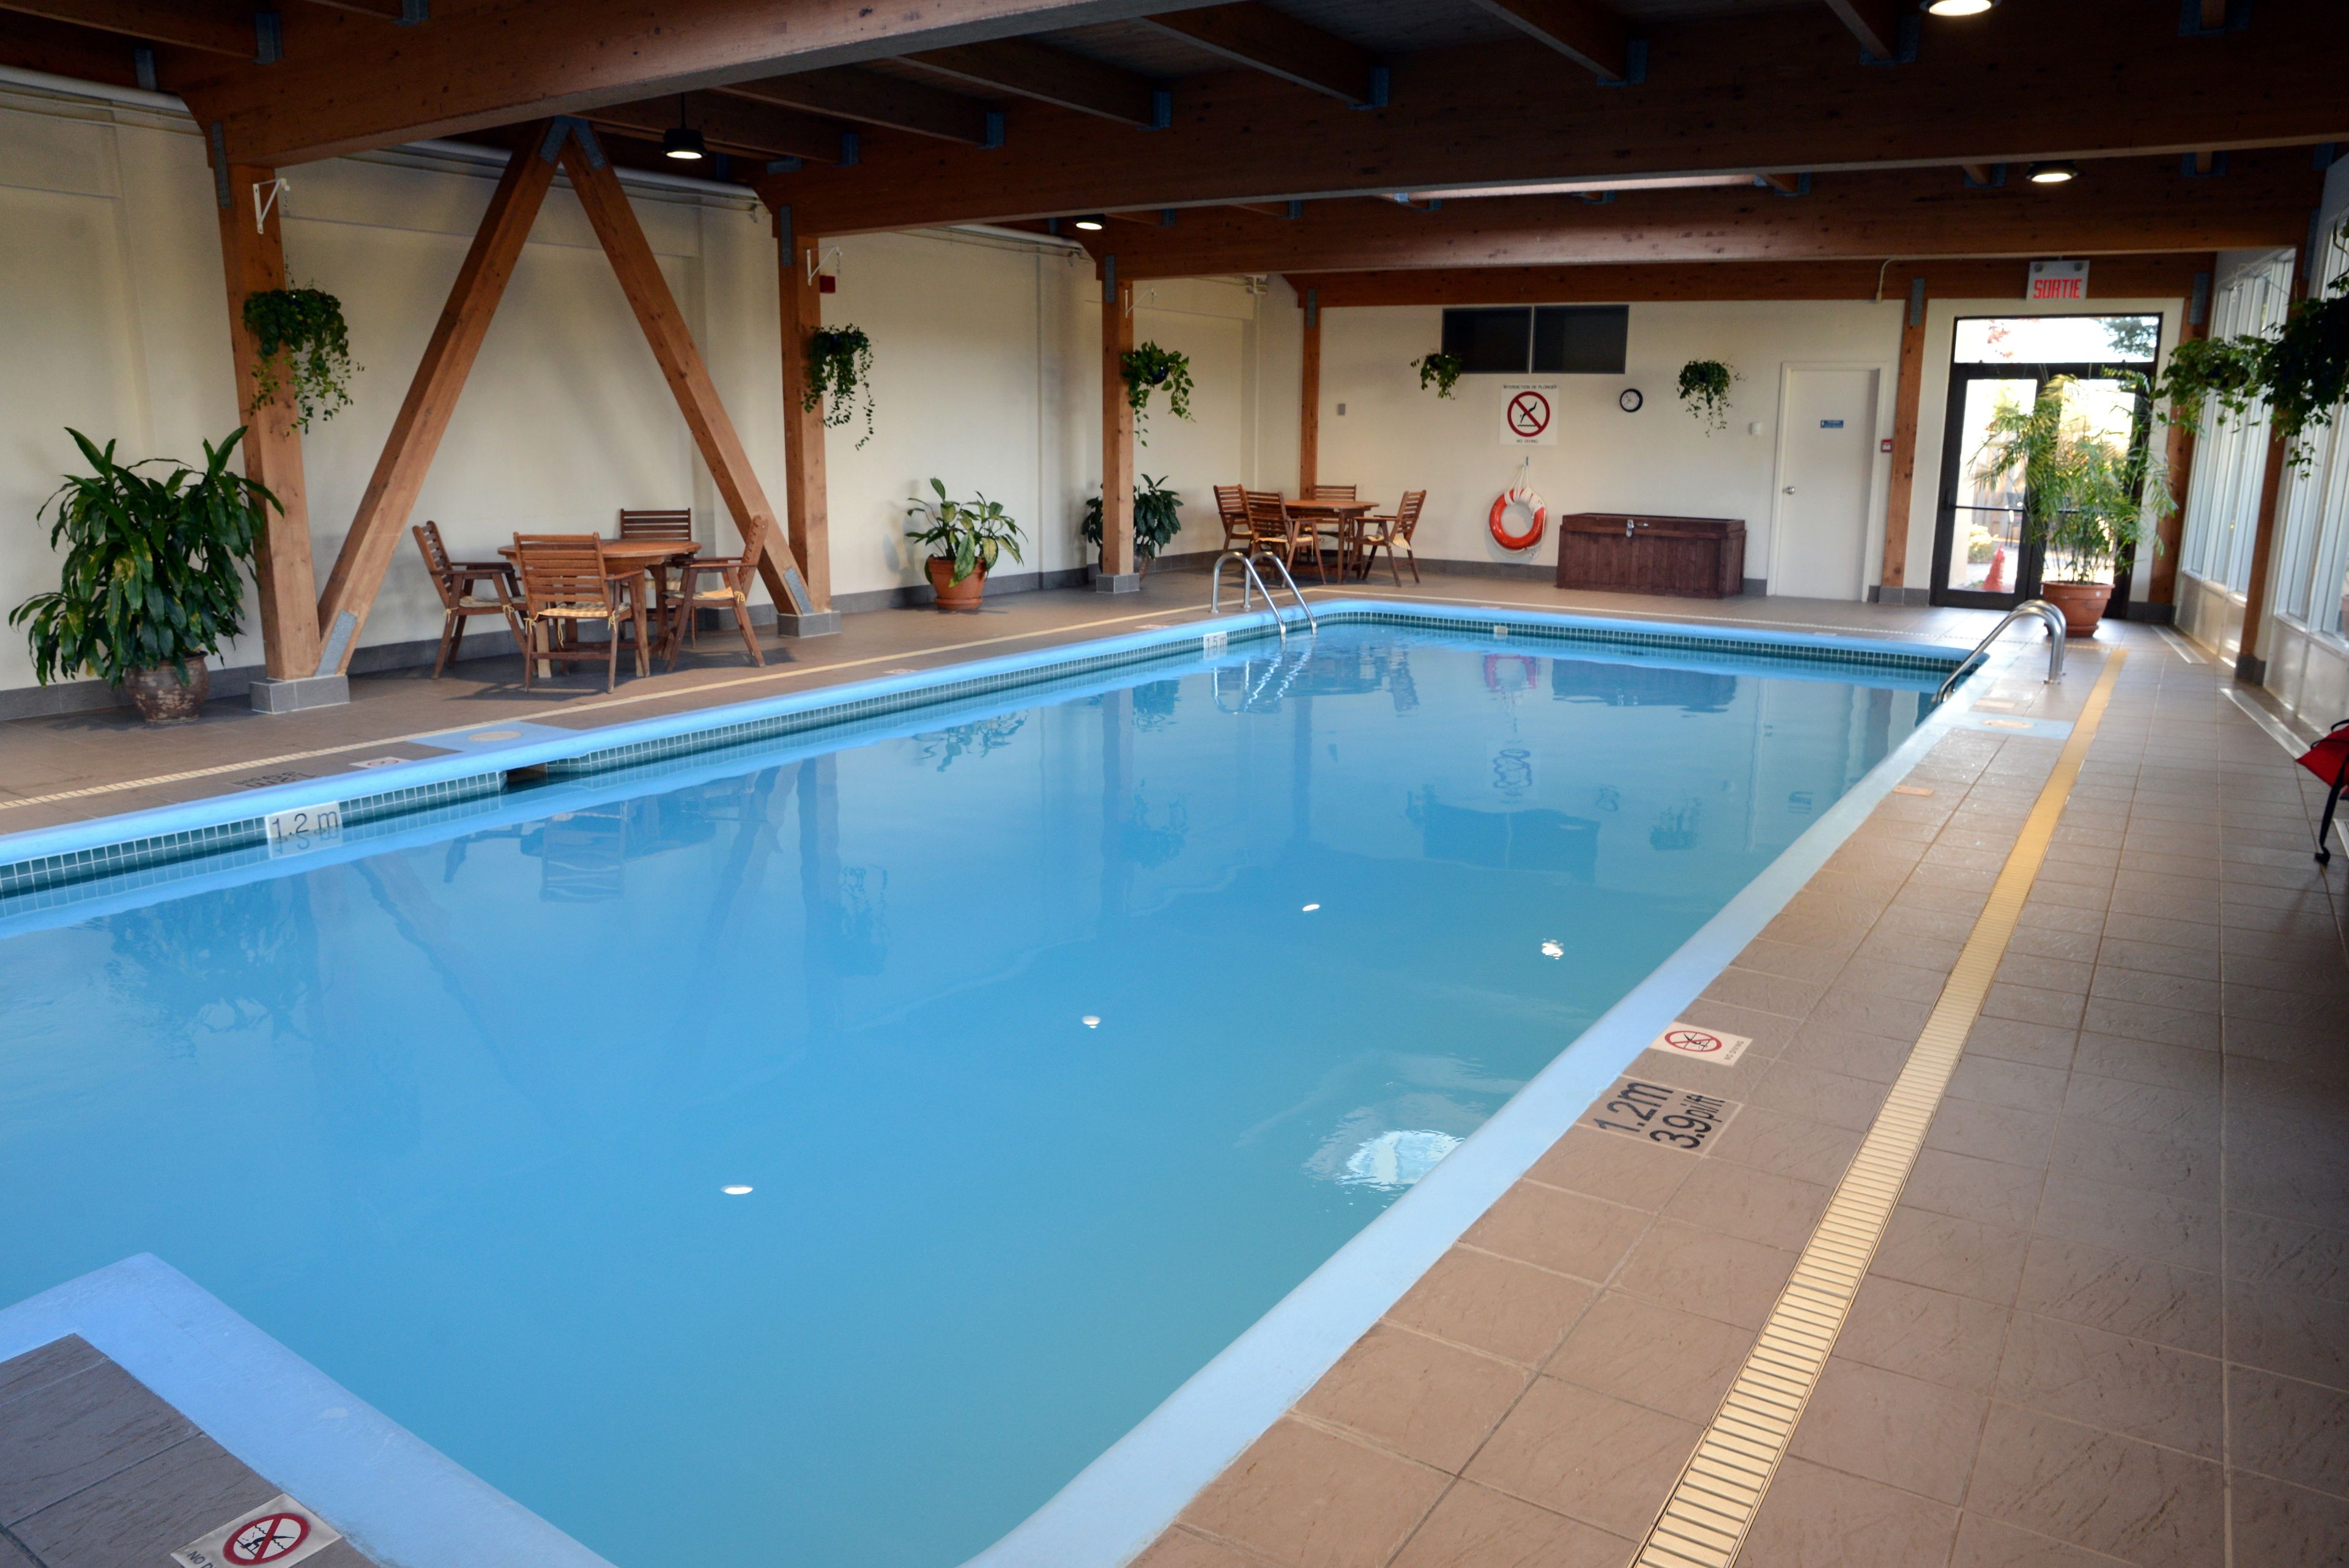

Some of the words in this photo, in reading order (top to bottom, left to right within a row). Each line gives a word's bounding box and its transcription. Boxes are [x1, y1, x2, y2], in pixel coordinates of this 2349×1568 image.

[2033, 278, 2082, 299] SORTIE
[272, 813, 308, 838] 1.2
[317, 811, 338, 830] m
[1594, 1082, 1673, 1132] 1.2m
[187, 1551, 206, 1564] NO
